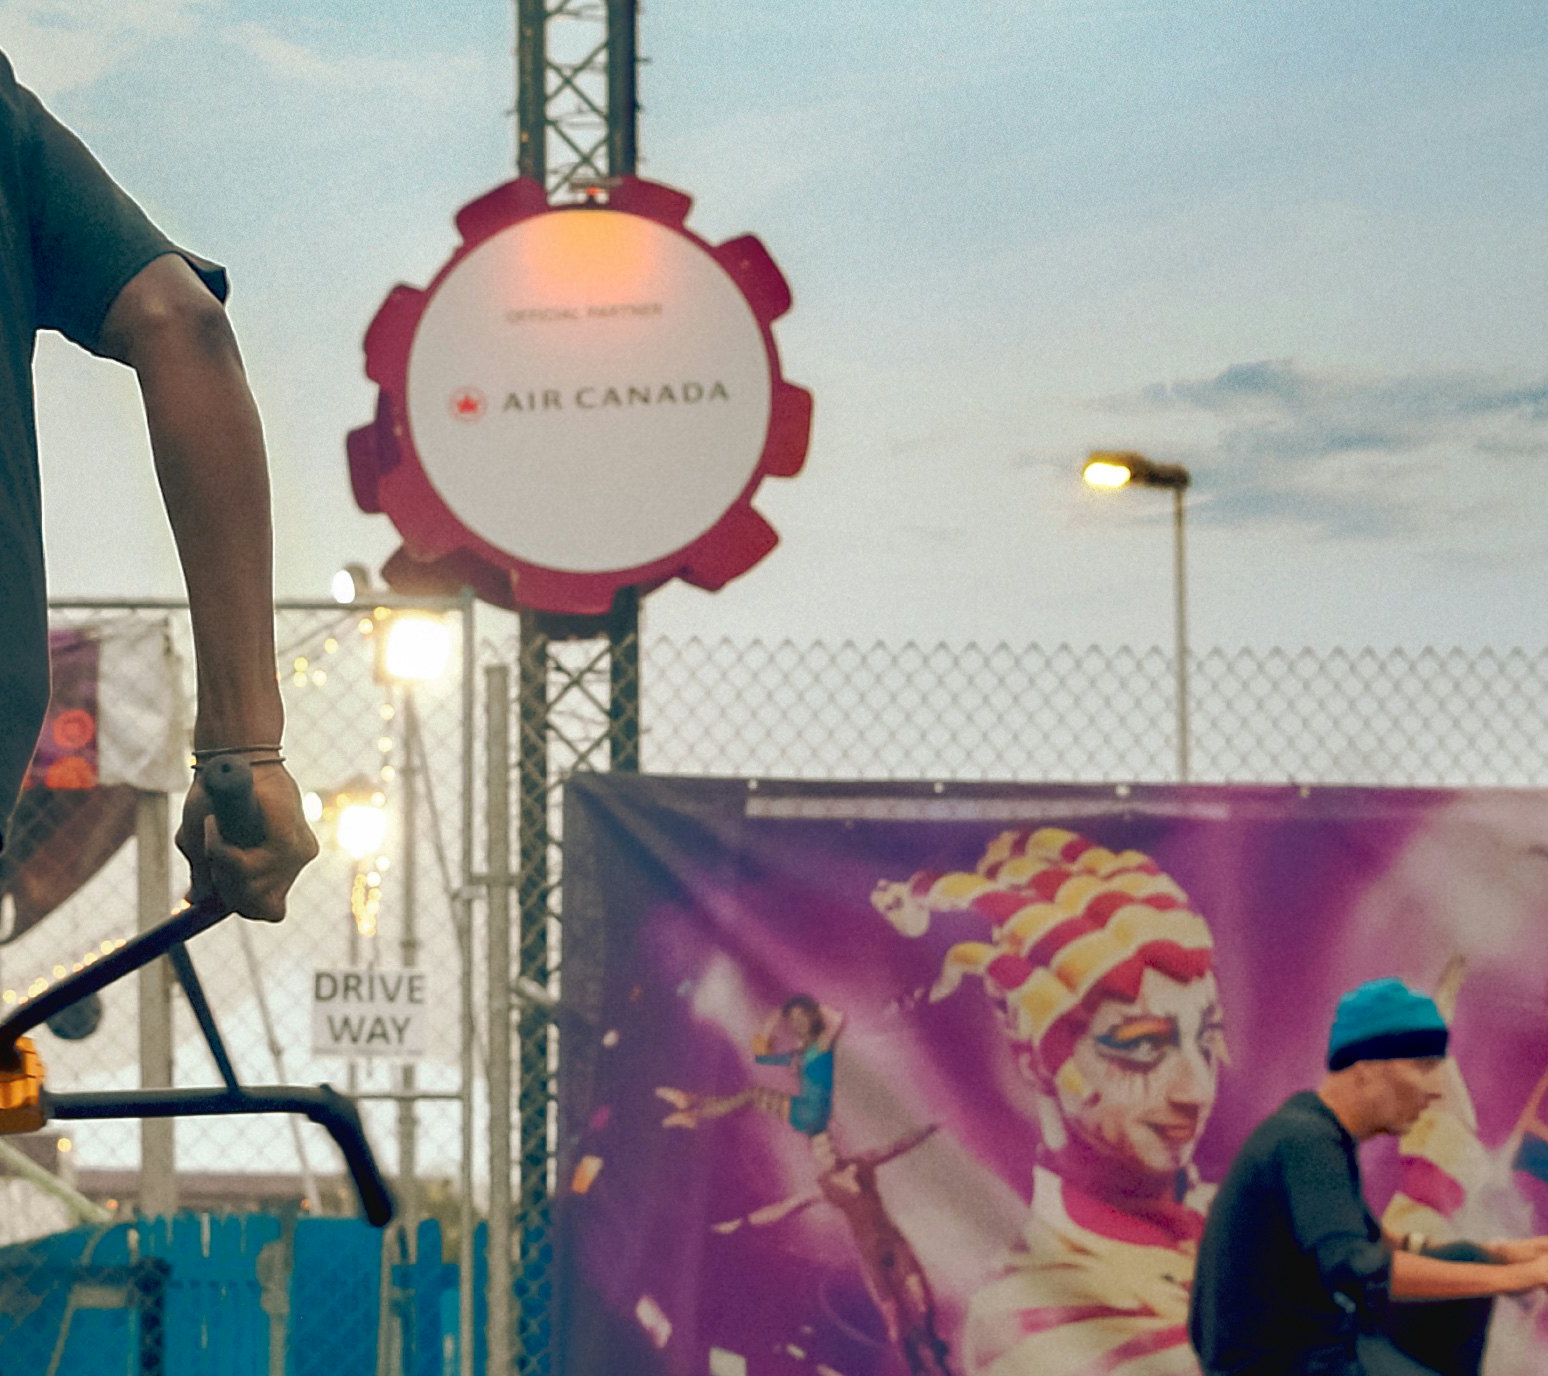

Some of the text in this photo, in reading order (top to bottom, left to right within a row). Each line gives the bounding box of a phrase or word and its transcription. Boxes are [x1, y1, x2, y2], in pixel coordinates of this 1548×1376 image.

[504, 380, 730, 413] AIR CANADA
[314, 972, 425, 1004] DRIVE
[327, 1015, 411, 1044] WAY
